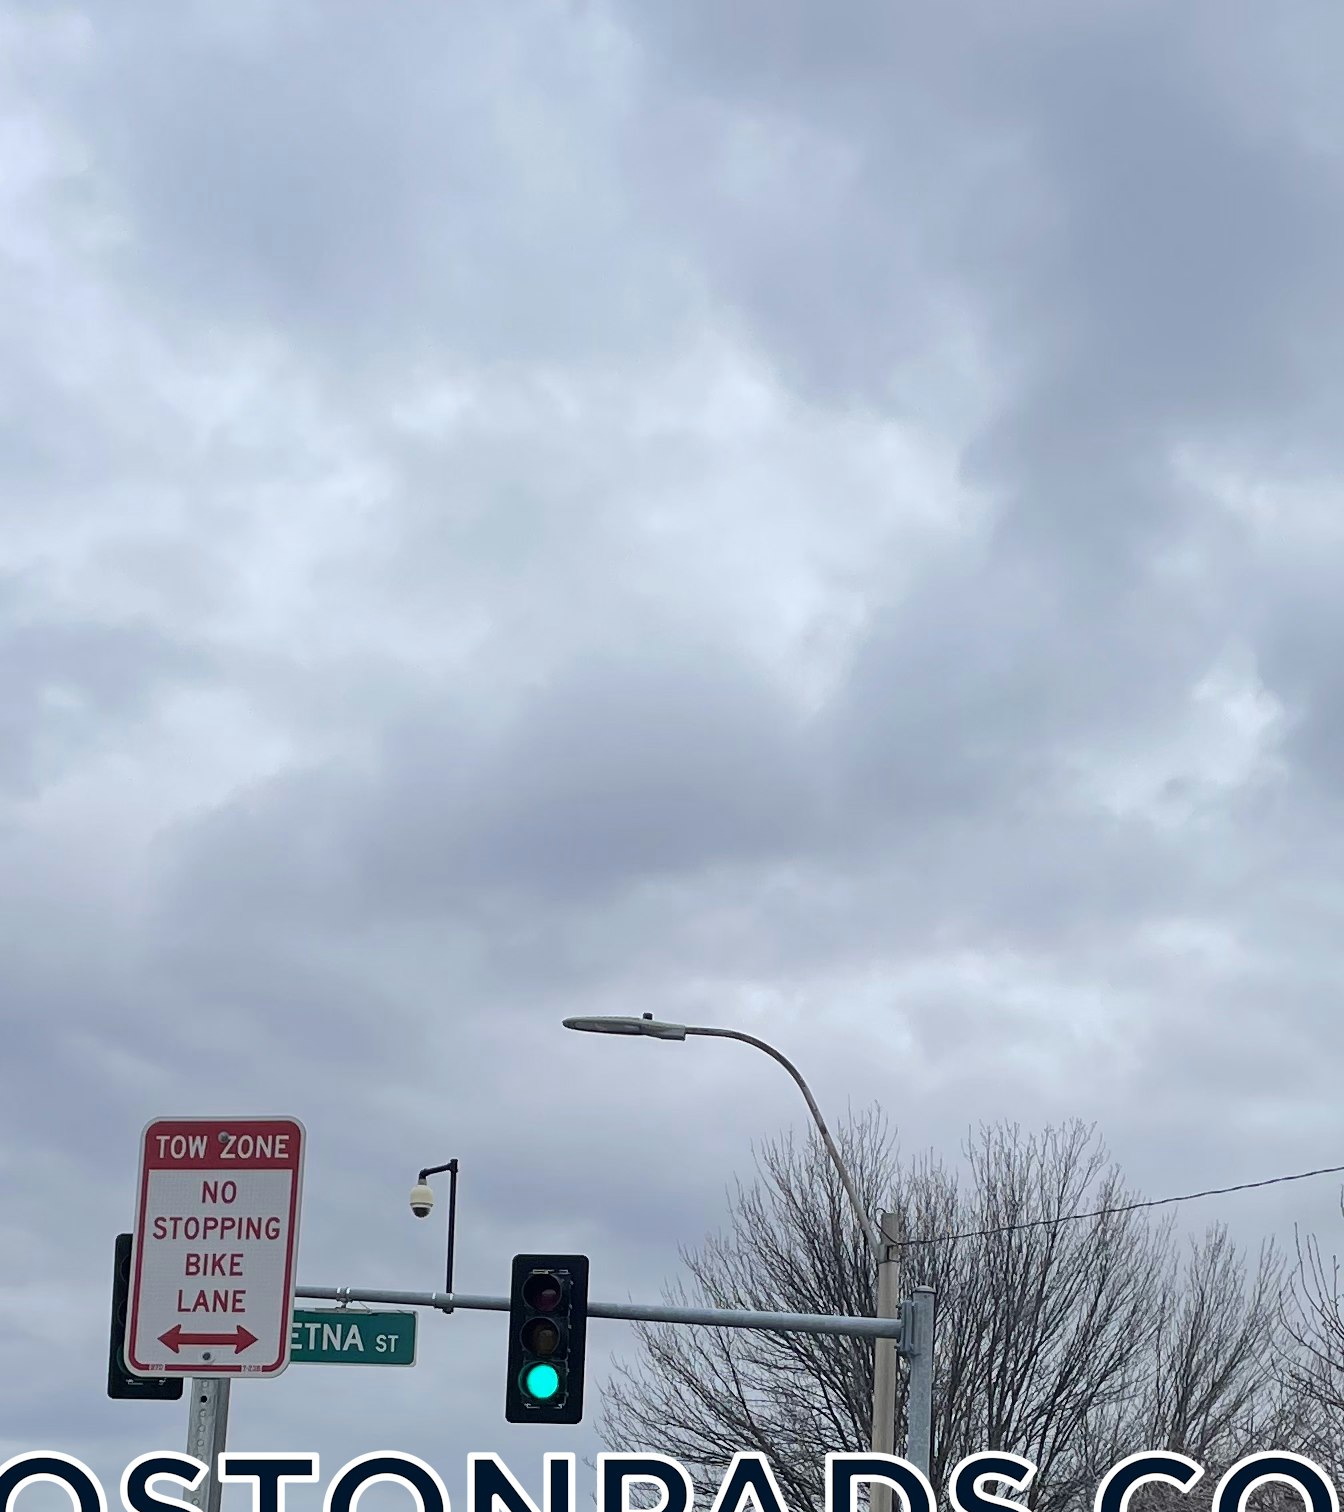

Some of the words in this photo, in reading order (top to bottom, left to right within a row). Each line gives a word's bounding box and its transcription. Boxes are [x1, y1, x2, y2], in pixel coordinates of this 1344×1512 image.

[156, 1135, 208, 1159] TOW
[220, 1134, 290, 1159] ZONE
[201, 1180, 238, 1204] NO
[152, 1216, 281, 1241] STOPPING
[185, 1253, 244, 1277] BIKE
[177, 1289, 247, 1313] LANE
[375, 1334, 400, 1354] ST
